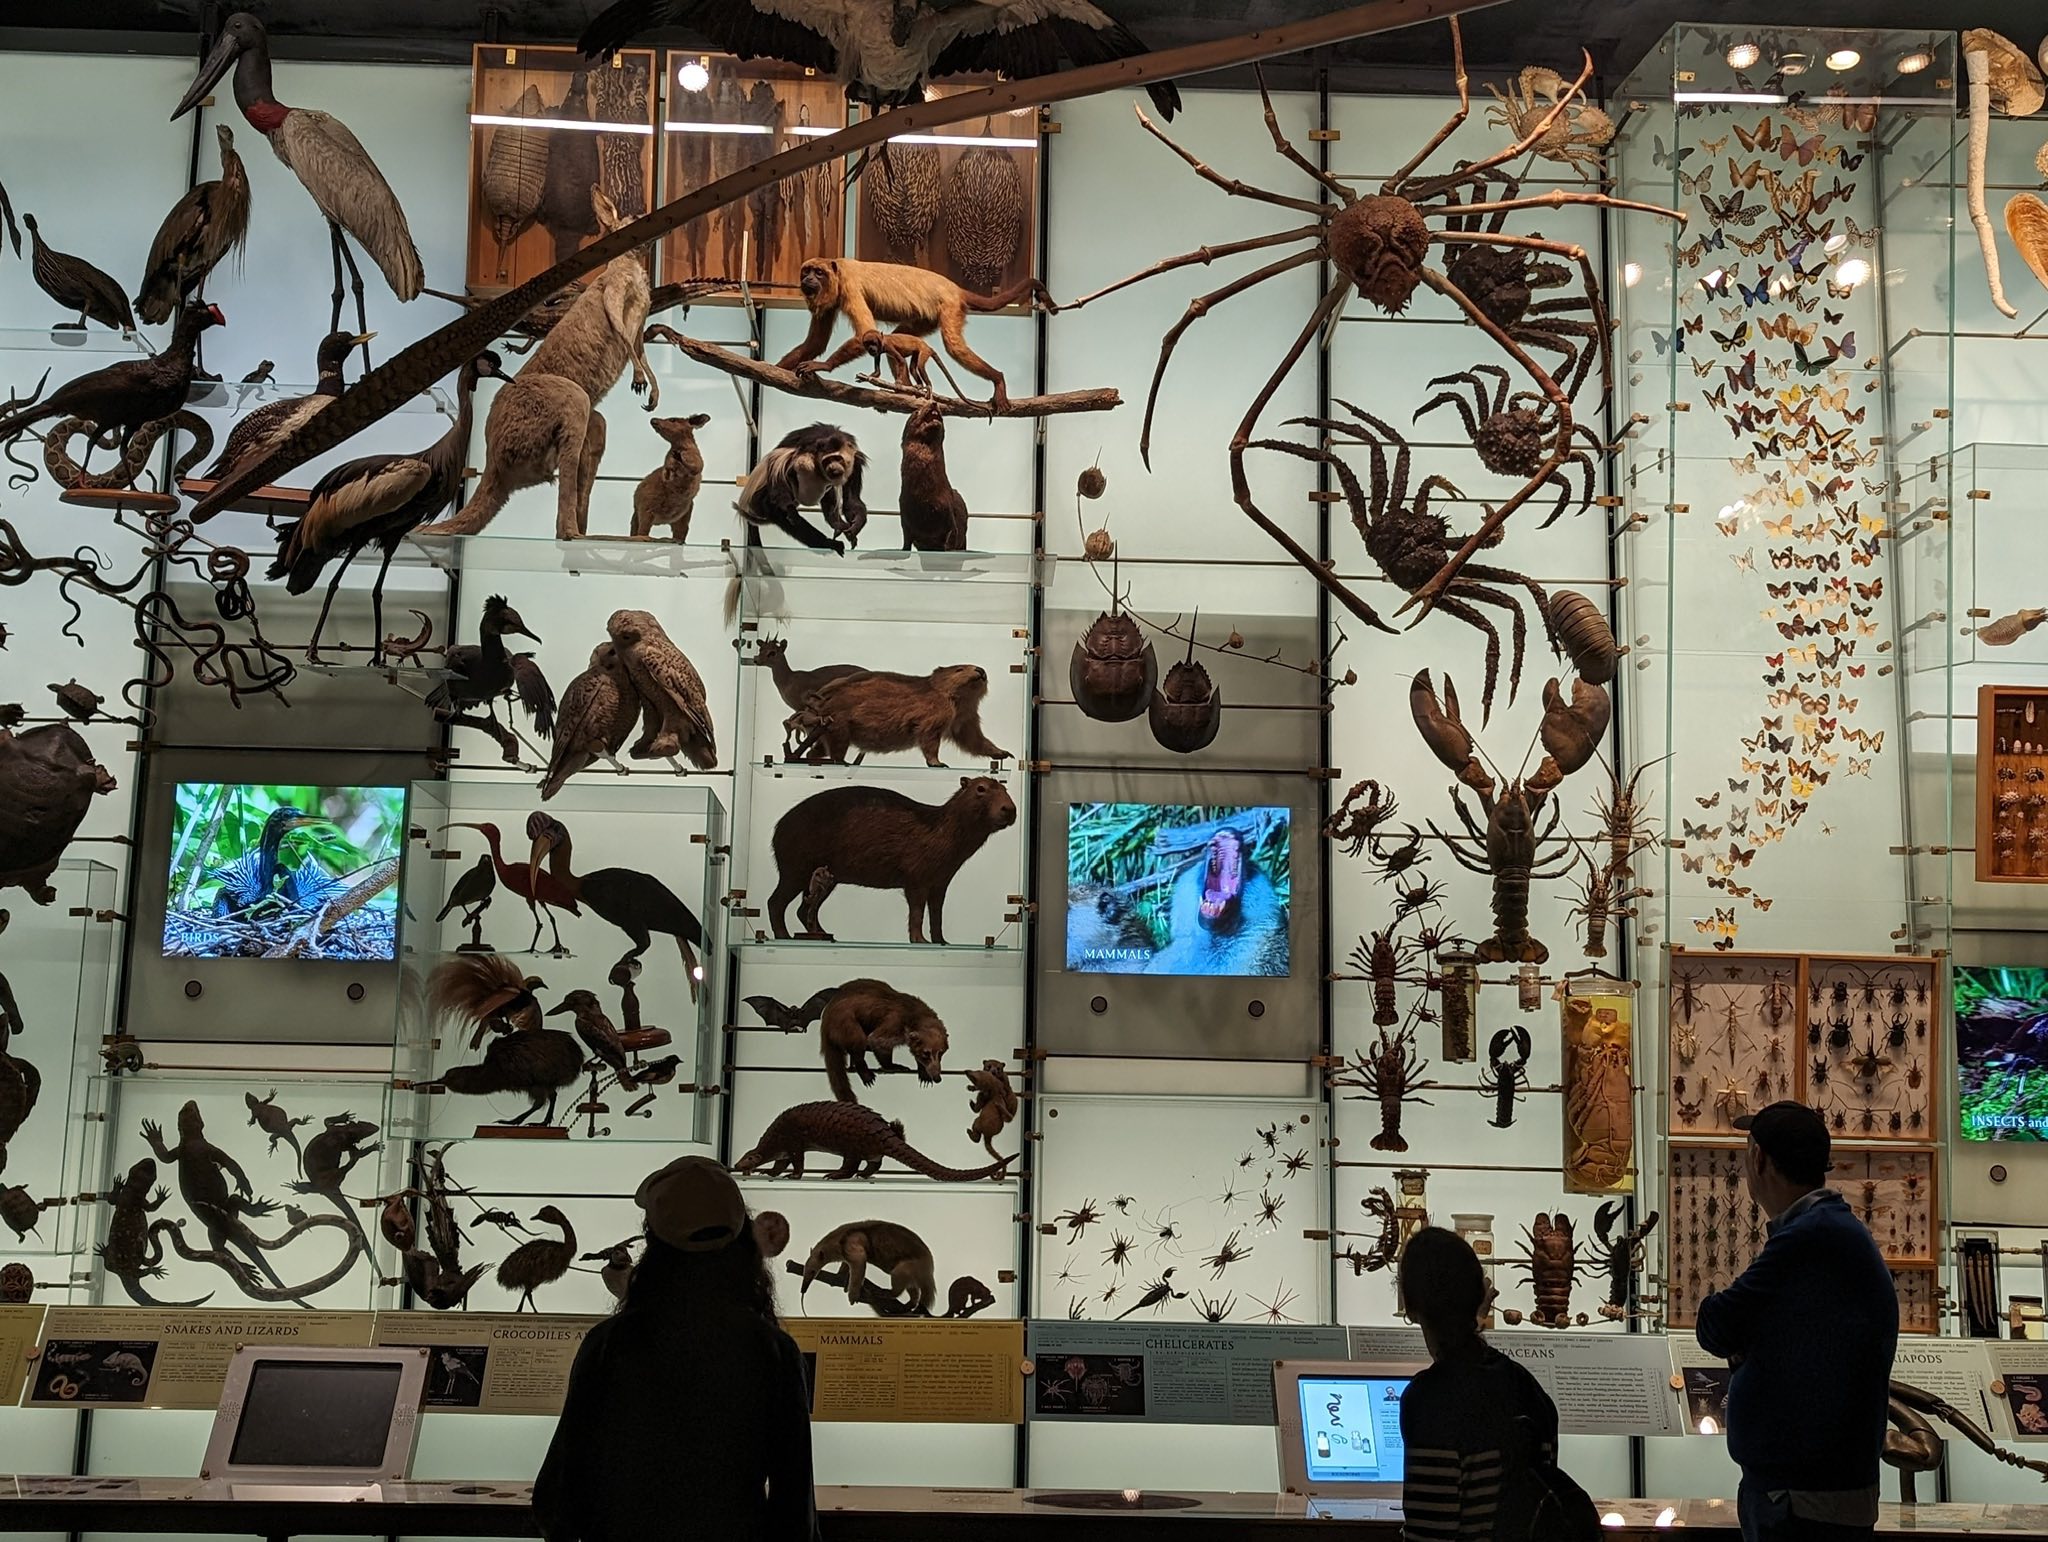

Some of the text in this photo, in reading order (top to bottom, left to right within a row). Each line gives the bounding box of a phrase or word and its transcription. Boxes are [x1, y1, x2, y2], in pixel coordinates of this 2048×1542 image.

[181, 932, 219, 942] BIRDS
[1085, 949, 1151, 959] MAMMALS
[1972, 1115, 2048, 1128] INSECTS and
[164, 1324, 211, 1335] SNAKES
[215, 1325, 242, 1335] AND
[246, 1326, 299, 1336] LIZARDS
[493, 1330, 571, 1340] CROCODILES
[820, 1336, 883, 1345] MAMMALS
[1145, 1339, 1234, 1350] CHELICERATES
[1894, 1354, 1943, 1363] IAPODS
